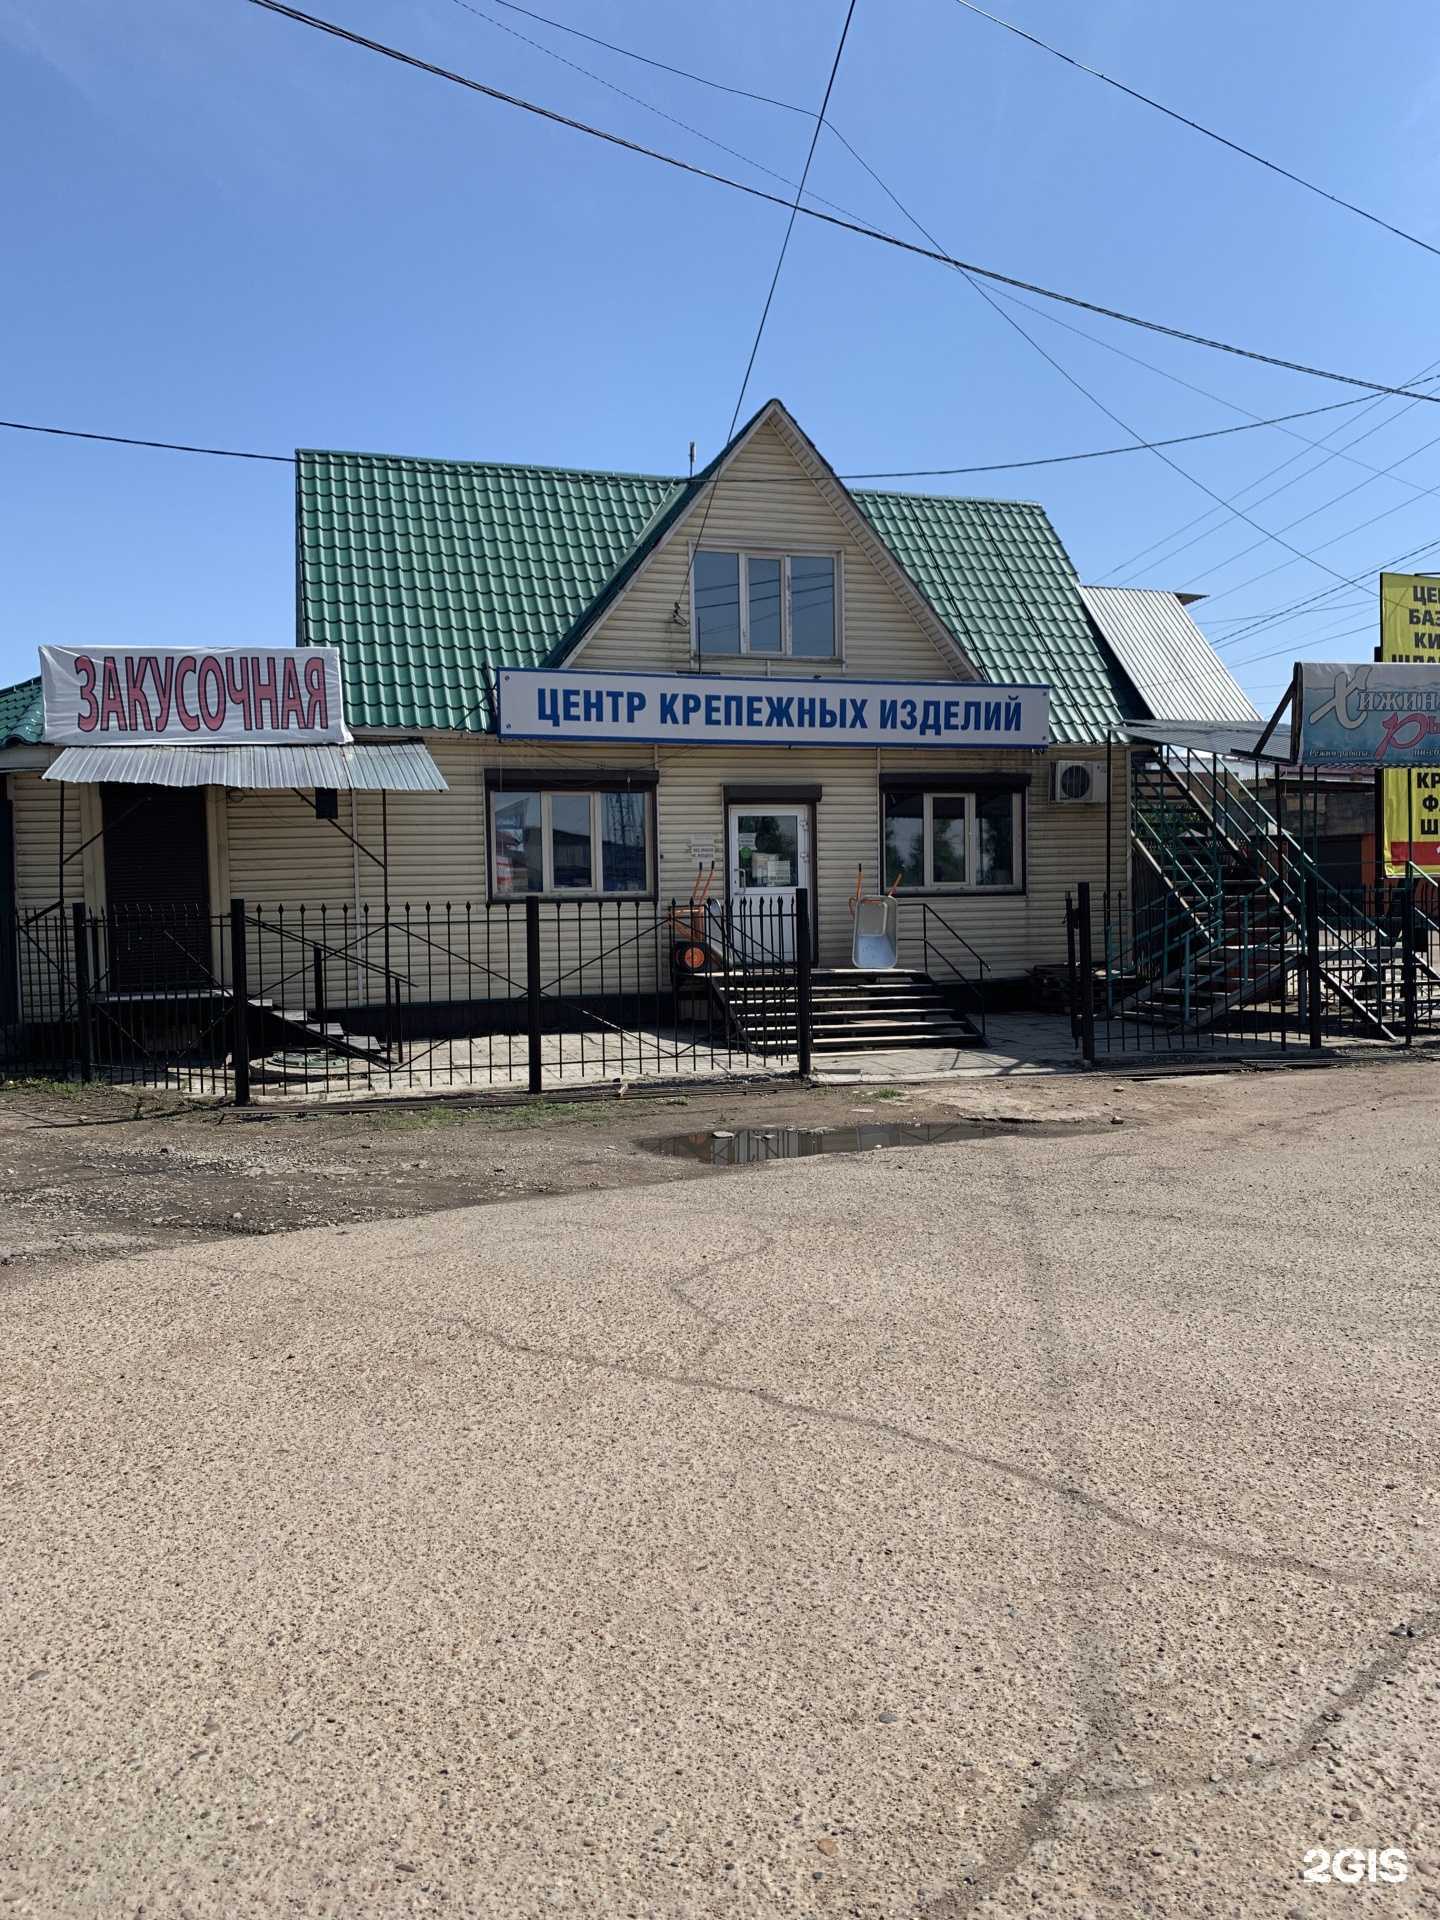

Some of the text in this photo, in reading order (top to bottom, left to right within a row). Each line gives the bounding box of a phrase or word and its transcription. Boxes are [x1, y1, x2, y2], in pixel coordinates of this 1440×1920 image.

[1413, 586, 1440, 605] ЦЕ
[74, 655, 329, 732] ЗАКУСОЧНАЯ
[537, 687, 1022, 736] ЦЕНТР КРЕПЕЖНЫХ ИЗДЕЛИЙ
